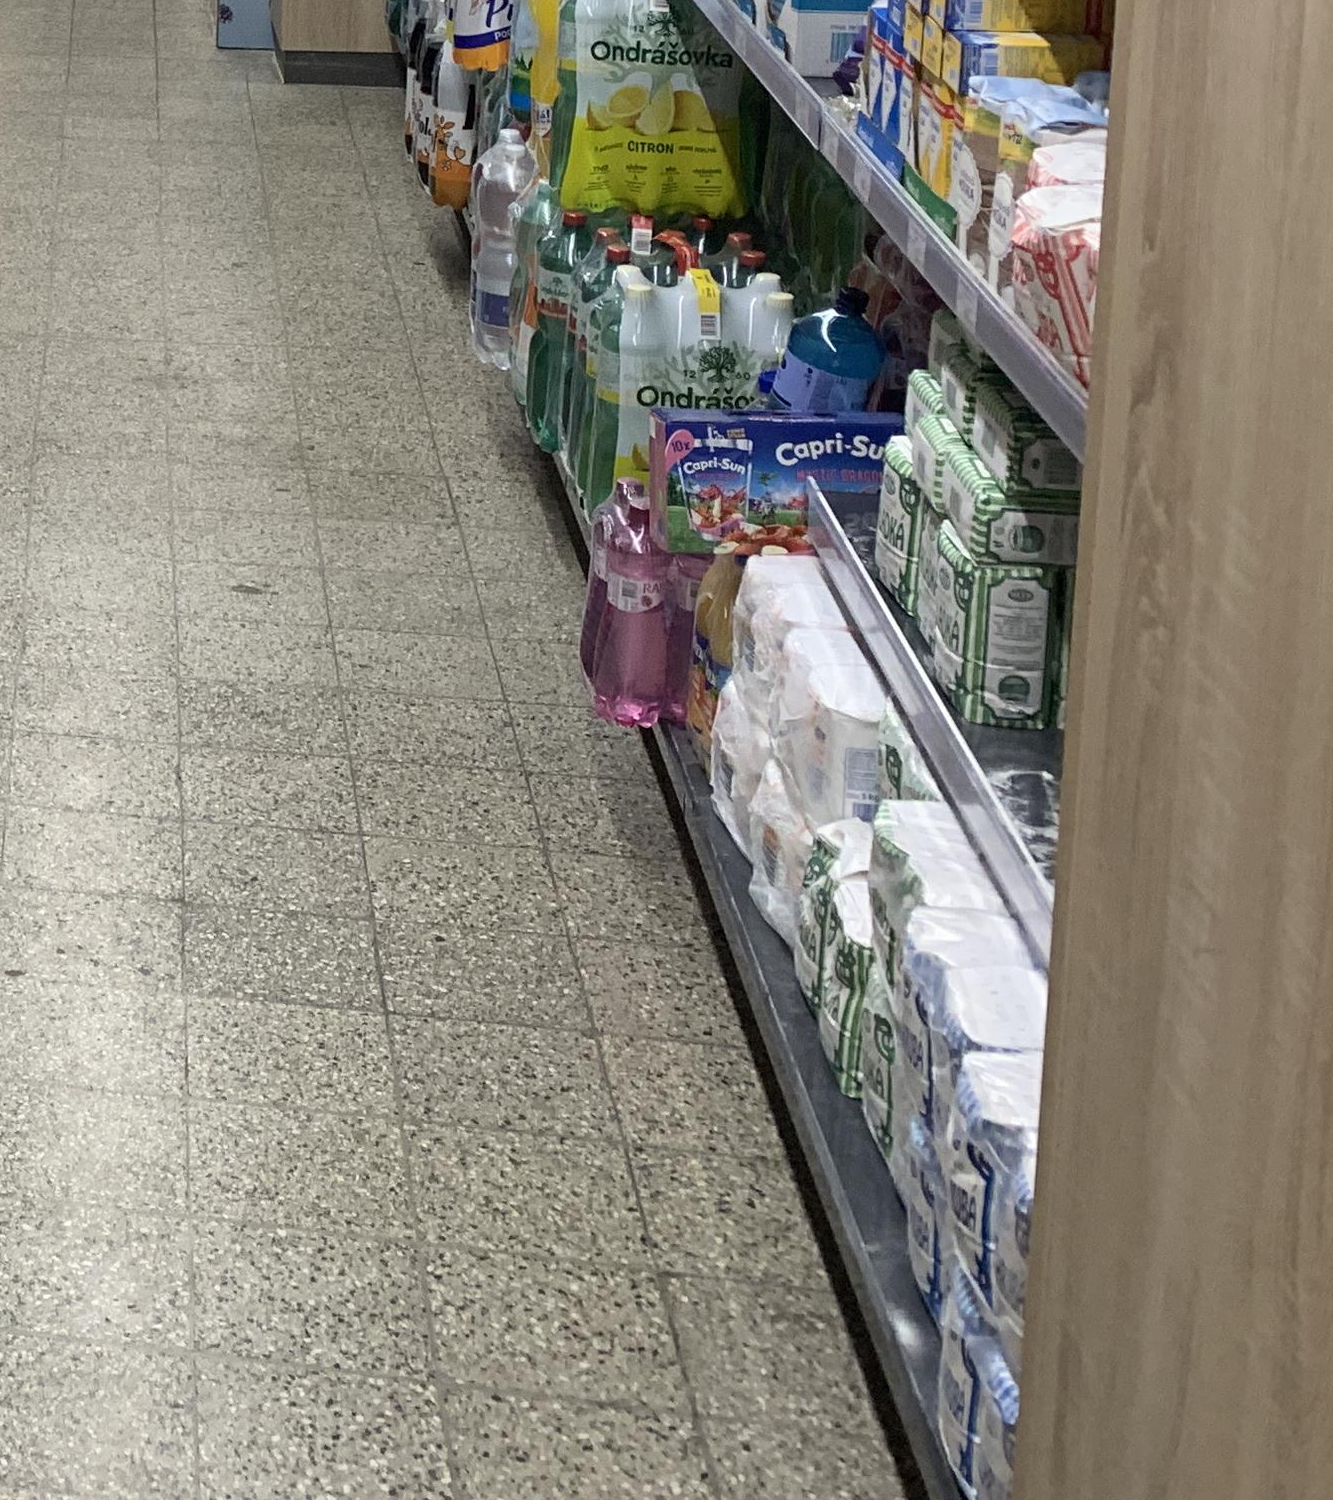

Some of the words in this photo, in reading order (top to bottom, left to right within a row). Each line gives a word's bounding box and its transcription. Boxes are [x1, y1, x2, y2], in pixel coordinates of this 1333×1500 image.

[590, 40, 733, 69] Ondrášovka
[627, 140, 674, 155] CITRON
[636, 385, 757, 410] Ondrášo
[670, 440, 692, 454] 10x
[775, 431, 885, 467] Capri-Su
[683, 457, 746, 476] Capri-Sun
